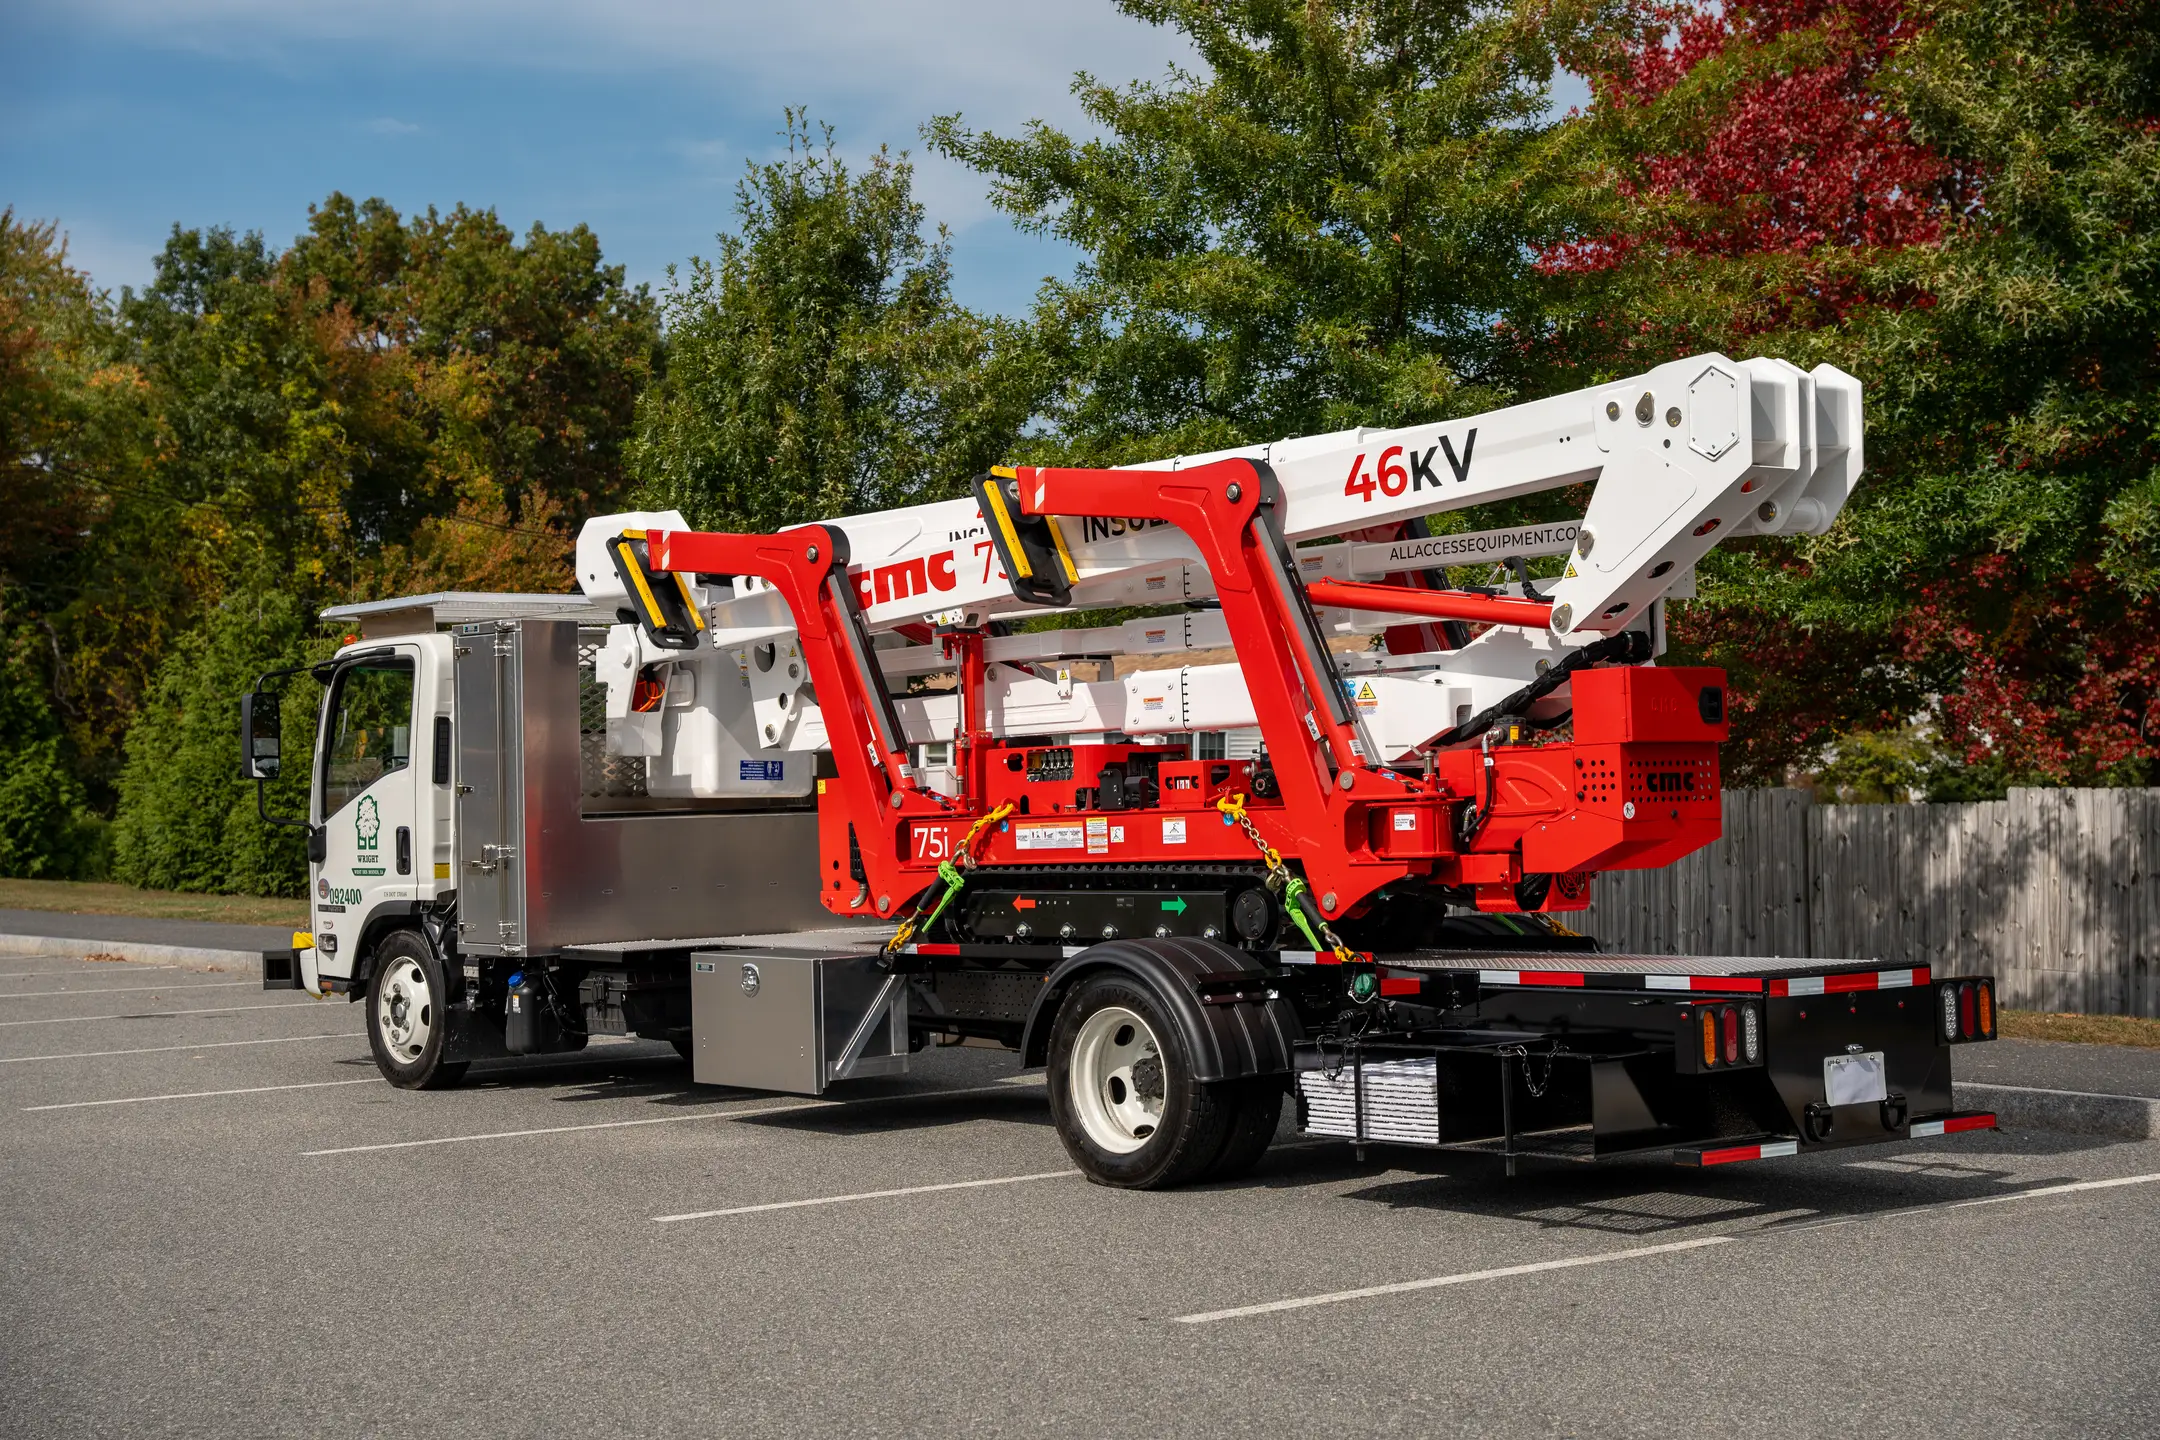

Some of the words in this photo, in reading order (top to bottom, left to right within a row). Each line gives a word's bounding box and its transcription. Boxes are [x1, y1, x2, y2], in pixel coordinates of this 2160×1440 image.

[1390, 526, 1583, 561] ALLACCESSEQUIPMENT.CO
[974, 540, 1008, 584] 7
[914, 827, 949, 858] 75i
[357, 855, 378, 863] WRIGHT
[330, 888, 362, 904] 092400
